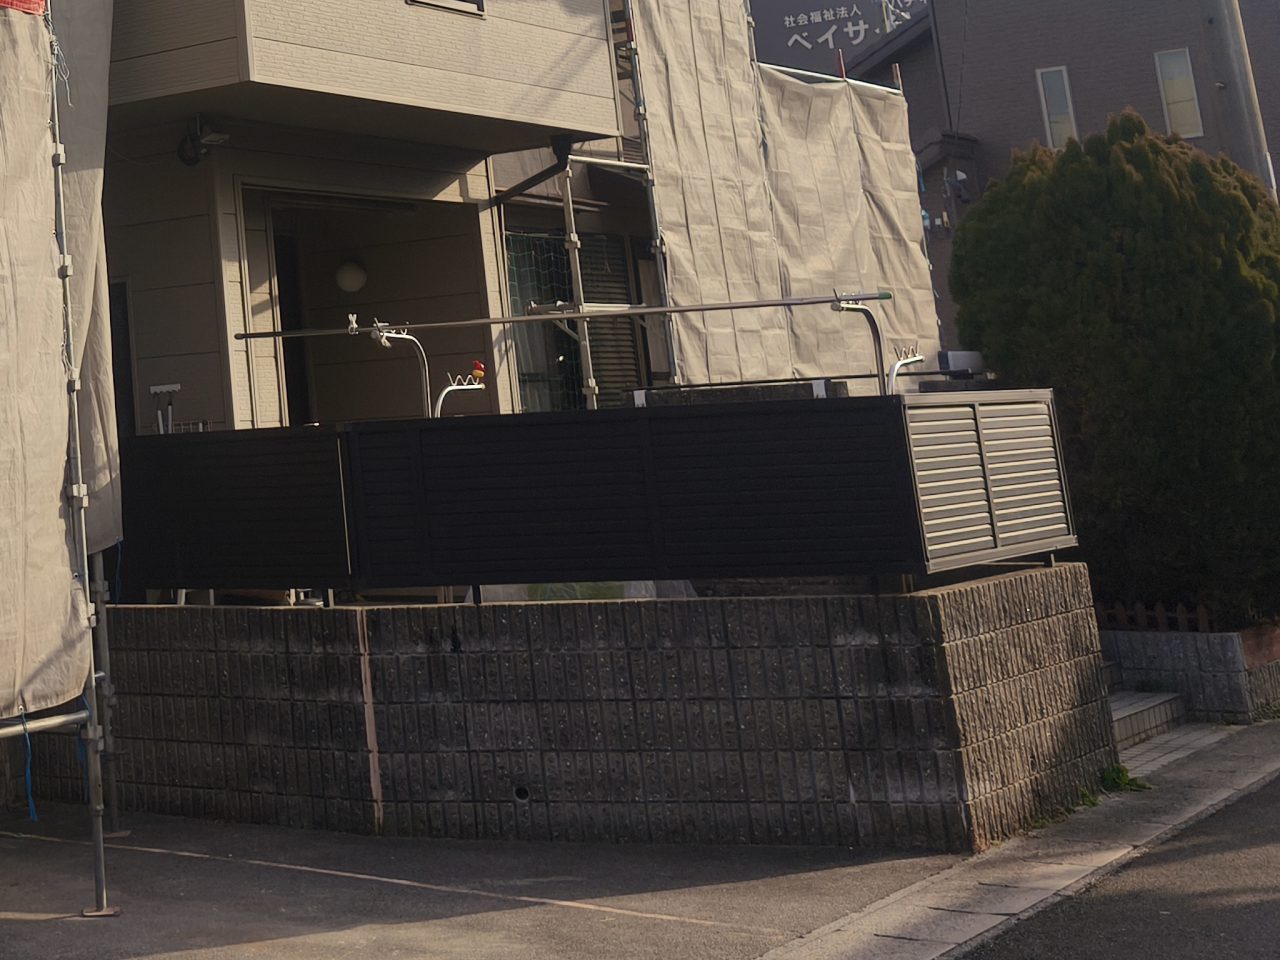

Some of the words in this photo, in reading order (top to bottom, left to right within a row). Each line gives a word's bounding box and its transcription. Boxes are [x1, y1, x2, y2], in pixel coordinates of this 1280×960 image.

[784, 3, 862, 28] 社会福祉法人
[787, 19, 880, 50] ベイサ
